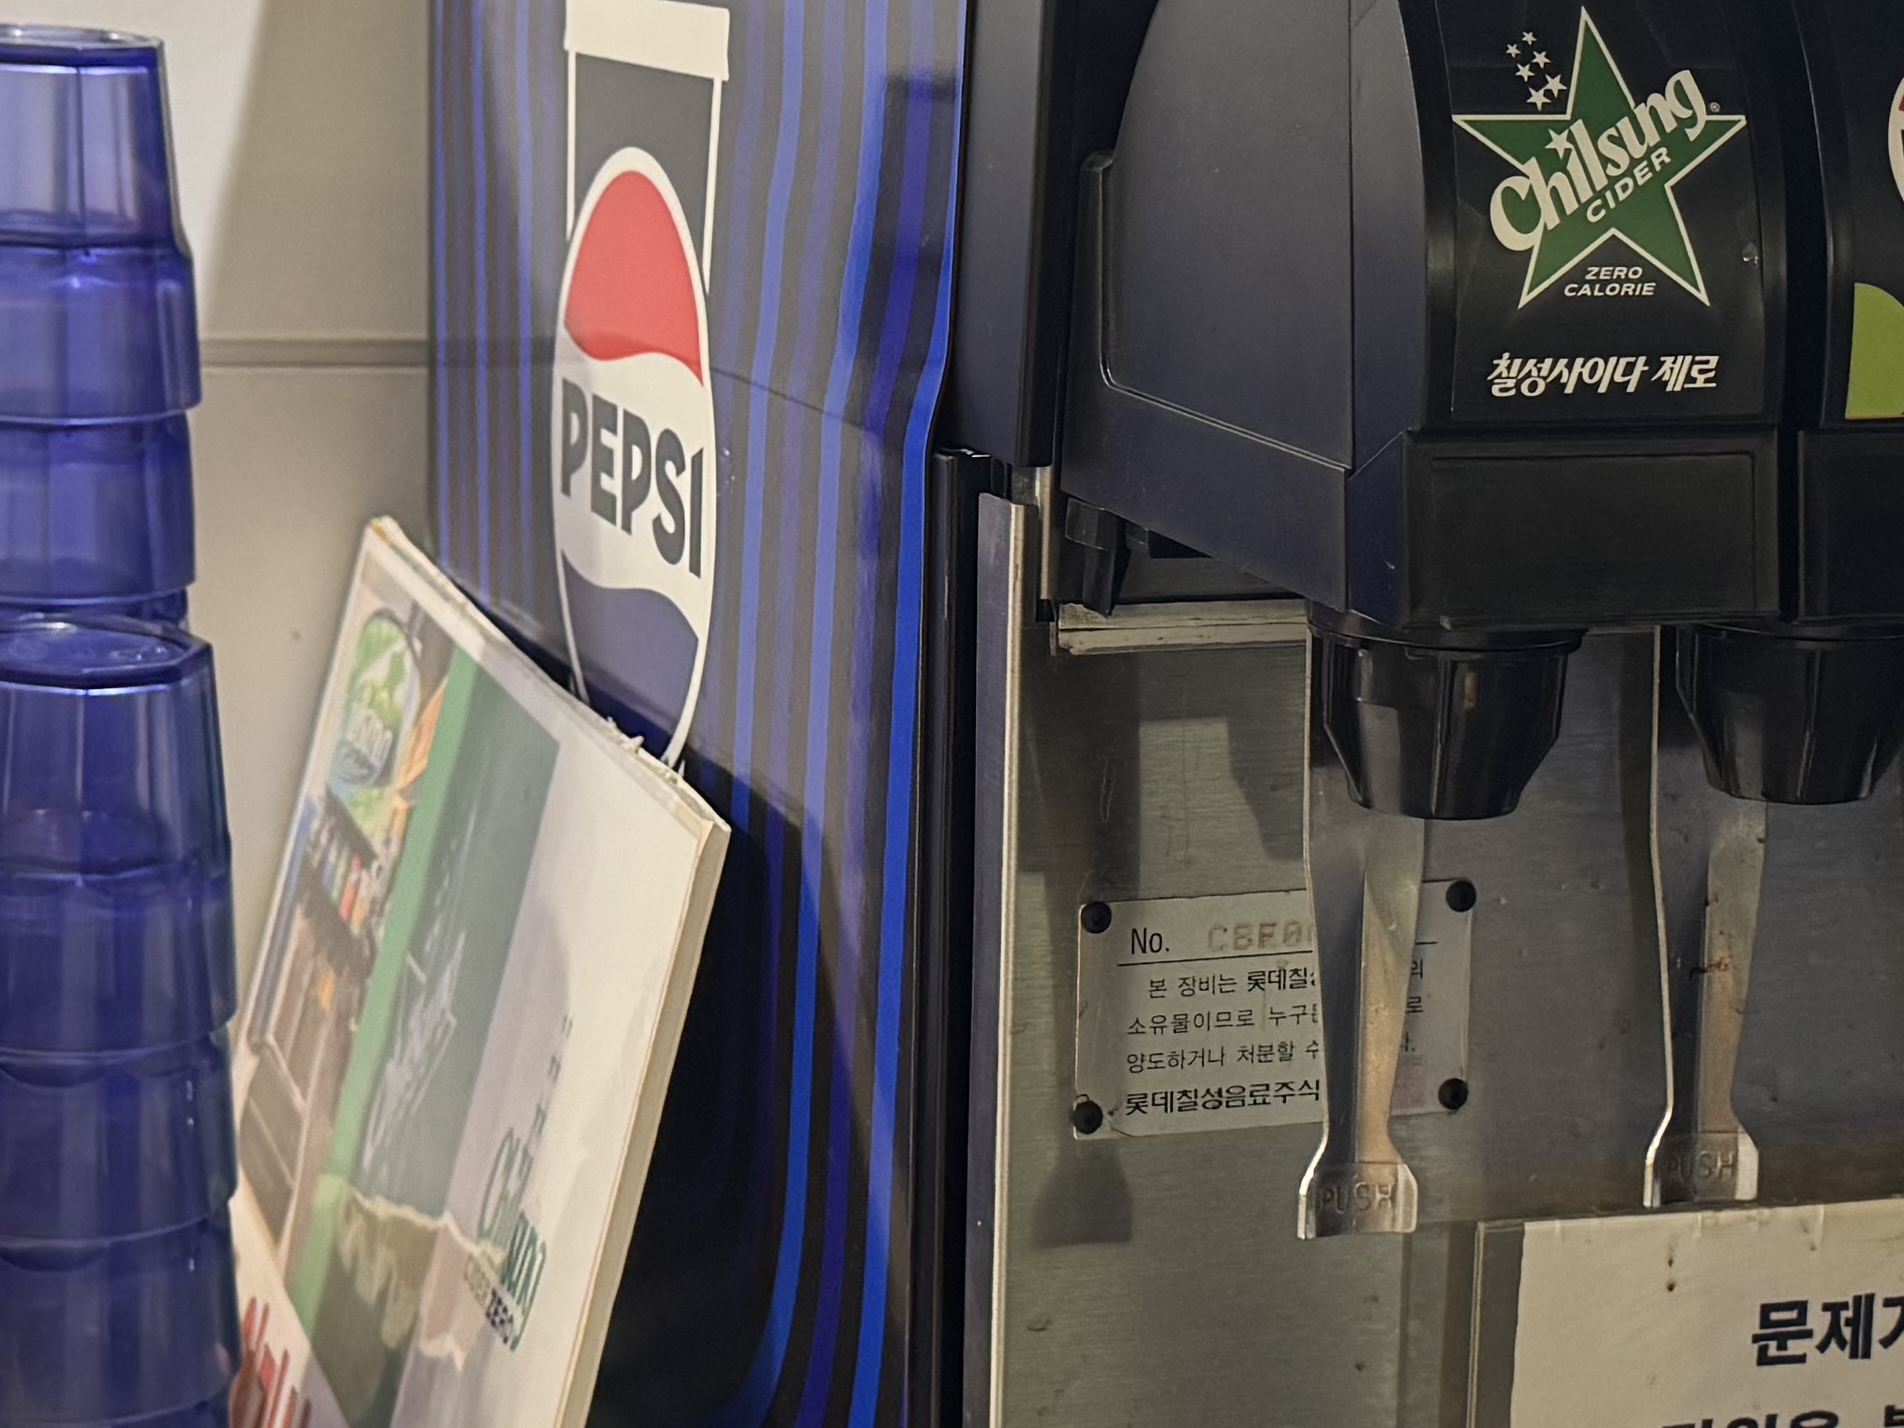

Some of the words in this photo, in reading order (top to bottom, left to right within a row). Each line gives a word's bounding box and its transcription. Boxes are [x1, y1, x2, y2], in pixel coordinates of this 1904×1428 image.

[1489, 69, 1708, 253] Chilsung
[1586, 147, 1672, 224] CIDER
[1563, 282, 1655, 298] CALORIE
[1585, 267, 1643, 281] ZERO
[1487, 353, 1649, 397] 칠성사이다
[1650, 354, 1720, 391] 제로
[561, 378, 703, 579] PEPSI
[1131, 927, 1170, 955] No.
[1148, 977, 1167, 1000] 본
[1177, 973, 1238, 998] 장비는
[1127, 1008, 1255, 1037] 소유물이므로
[1126, 1046, 1226, 1074] 양도하거나
[1236, 1040, 1296, 1065] 처분할
[1125, 1079, 1321, 1116] 롯데칠성음료주식
